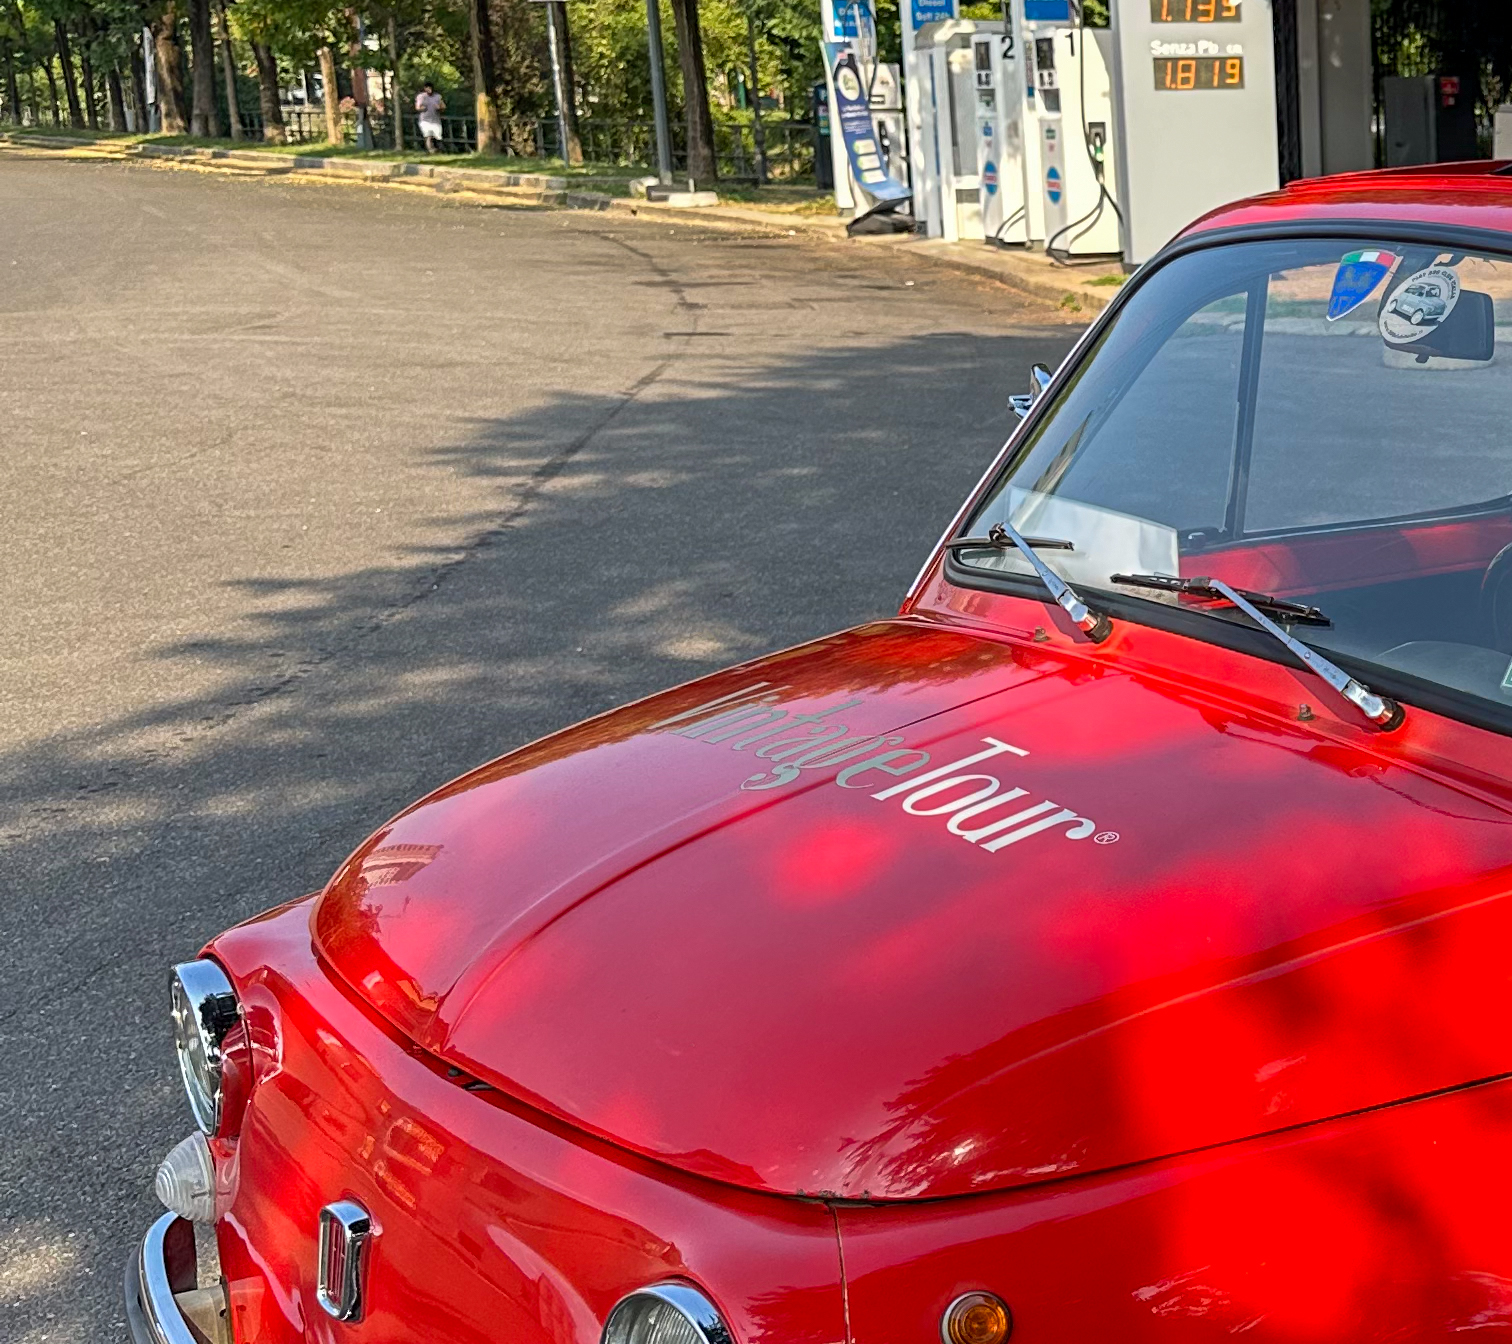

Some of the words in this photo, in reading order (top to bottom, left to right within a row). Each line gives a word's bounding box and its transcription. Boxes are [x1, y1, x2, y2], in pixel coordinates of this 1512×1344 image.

[1001, 35, 1015, 59] 2
[1064, 32, 1075, 57] 1
[1150, 39, 1196, 55] Senza
[1197, 40, 1219, 54] Pb
[1165, 59, 1240, 89] 1.819
